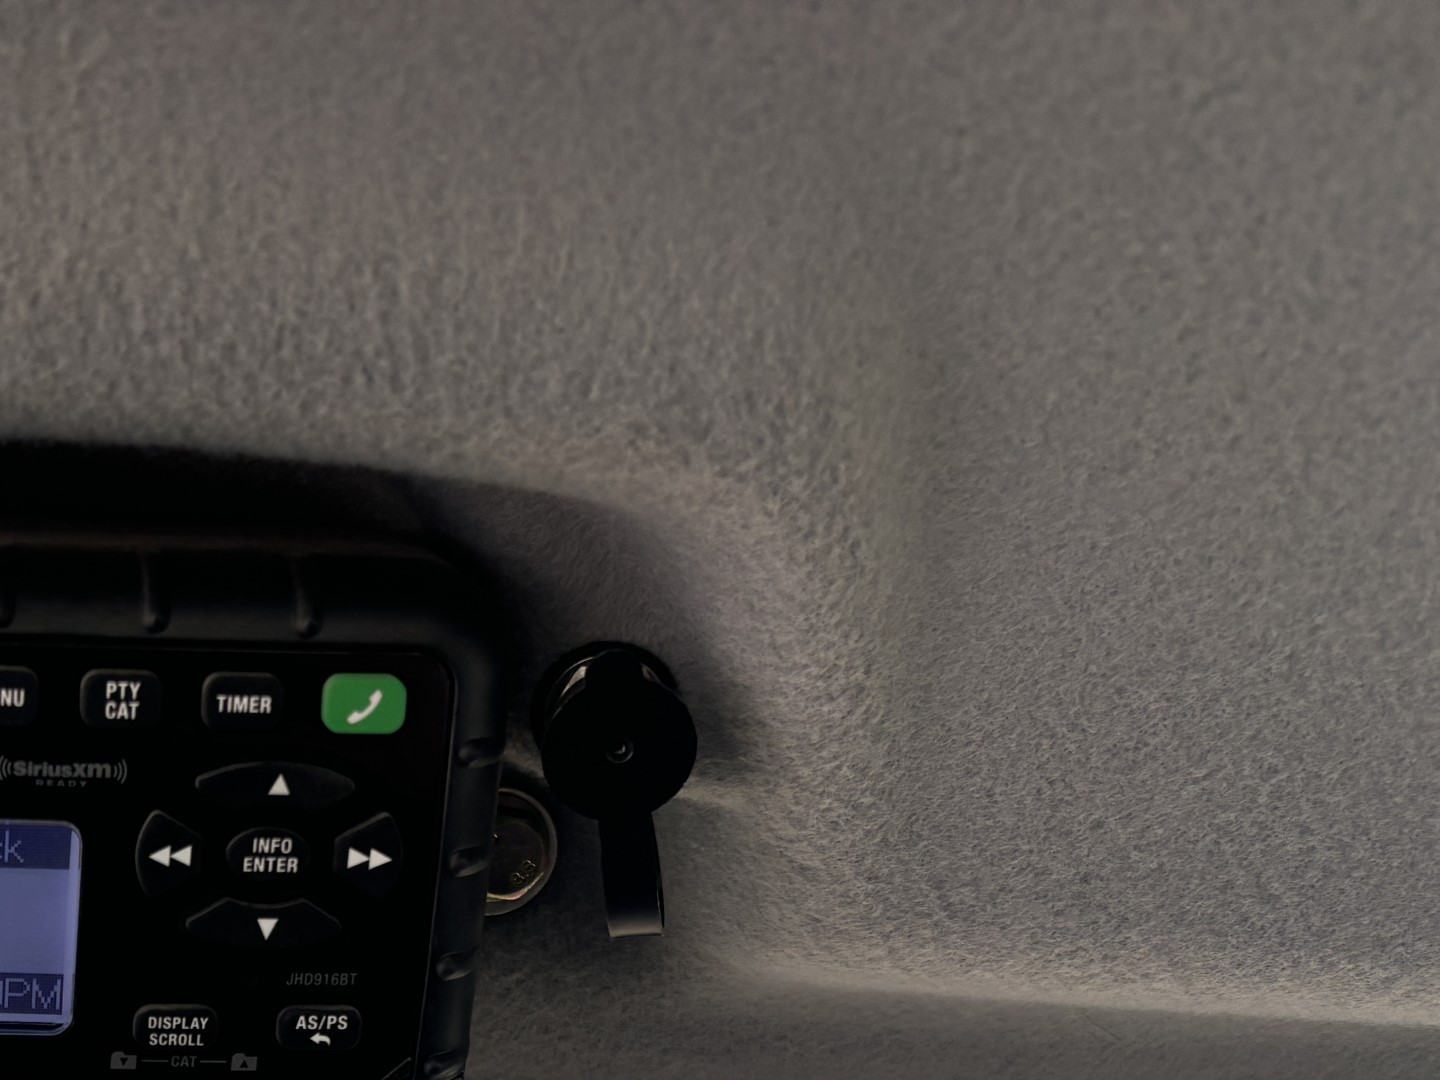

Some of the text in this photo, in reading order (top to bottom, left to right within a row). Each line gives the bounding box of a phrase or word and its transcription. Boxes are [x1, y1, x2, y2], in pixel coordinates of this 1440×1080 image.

[105, 681, 141, 700] PTY
[105, 701, 140, 720] CAT
[216, 694, 272, 714] TIMER
[35, 779, 88, 788] READY
[252, 837, 293, 854] INFO
[242, 857, 299, 873] ENTER
[286, 972, 358, 986] JHD916BT
[147, 1016, 209, 1030] DISPLAY
[295, 1015, 348, 1030] AS/PS
[148, 1033, 204, 1047] SCROLL
[171, 1055, 197, 1068] CAT
